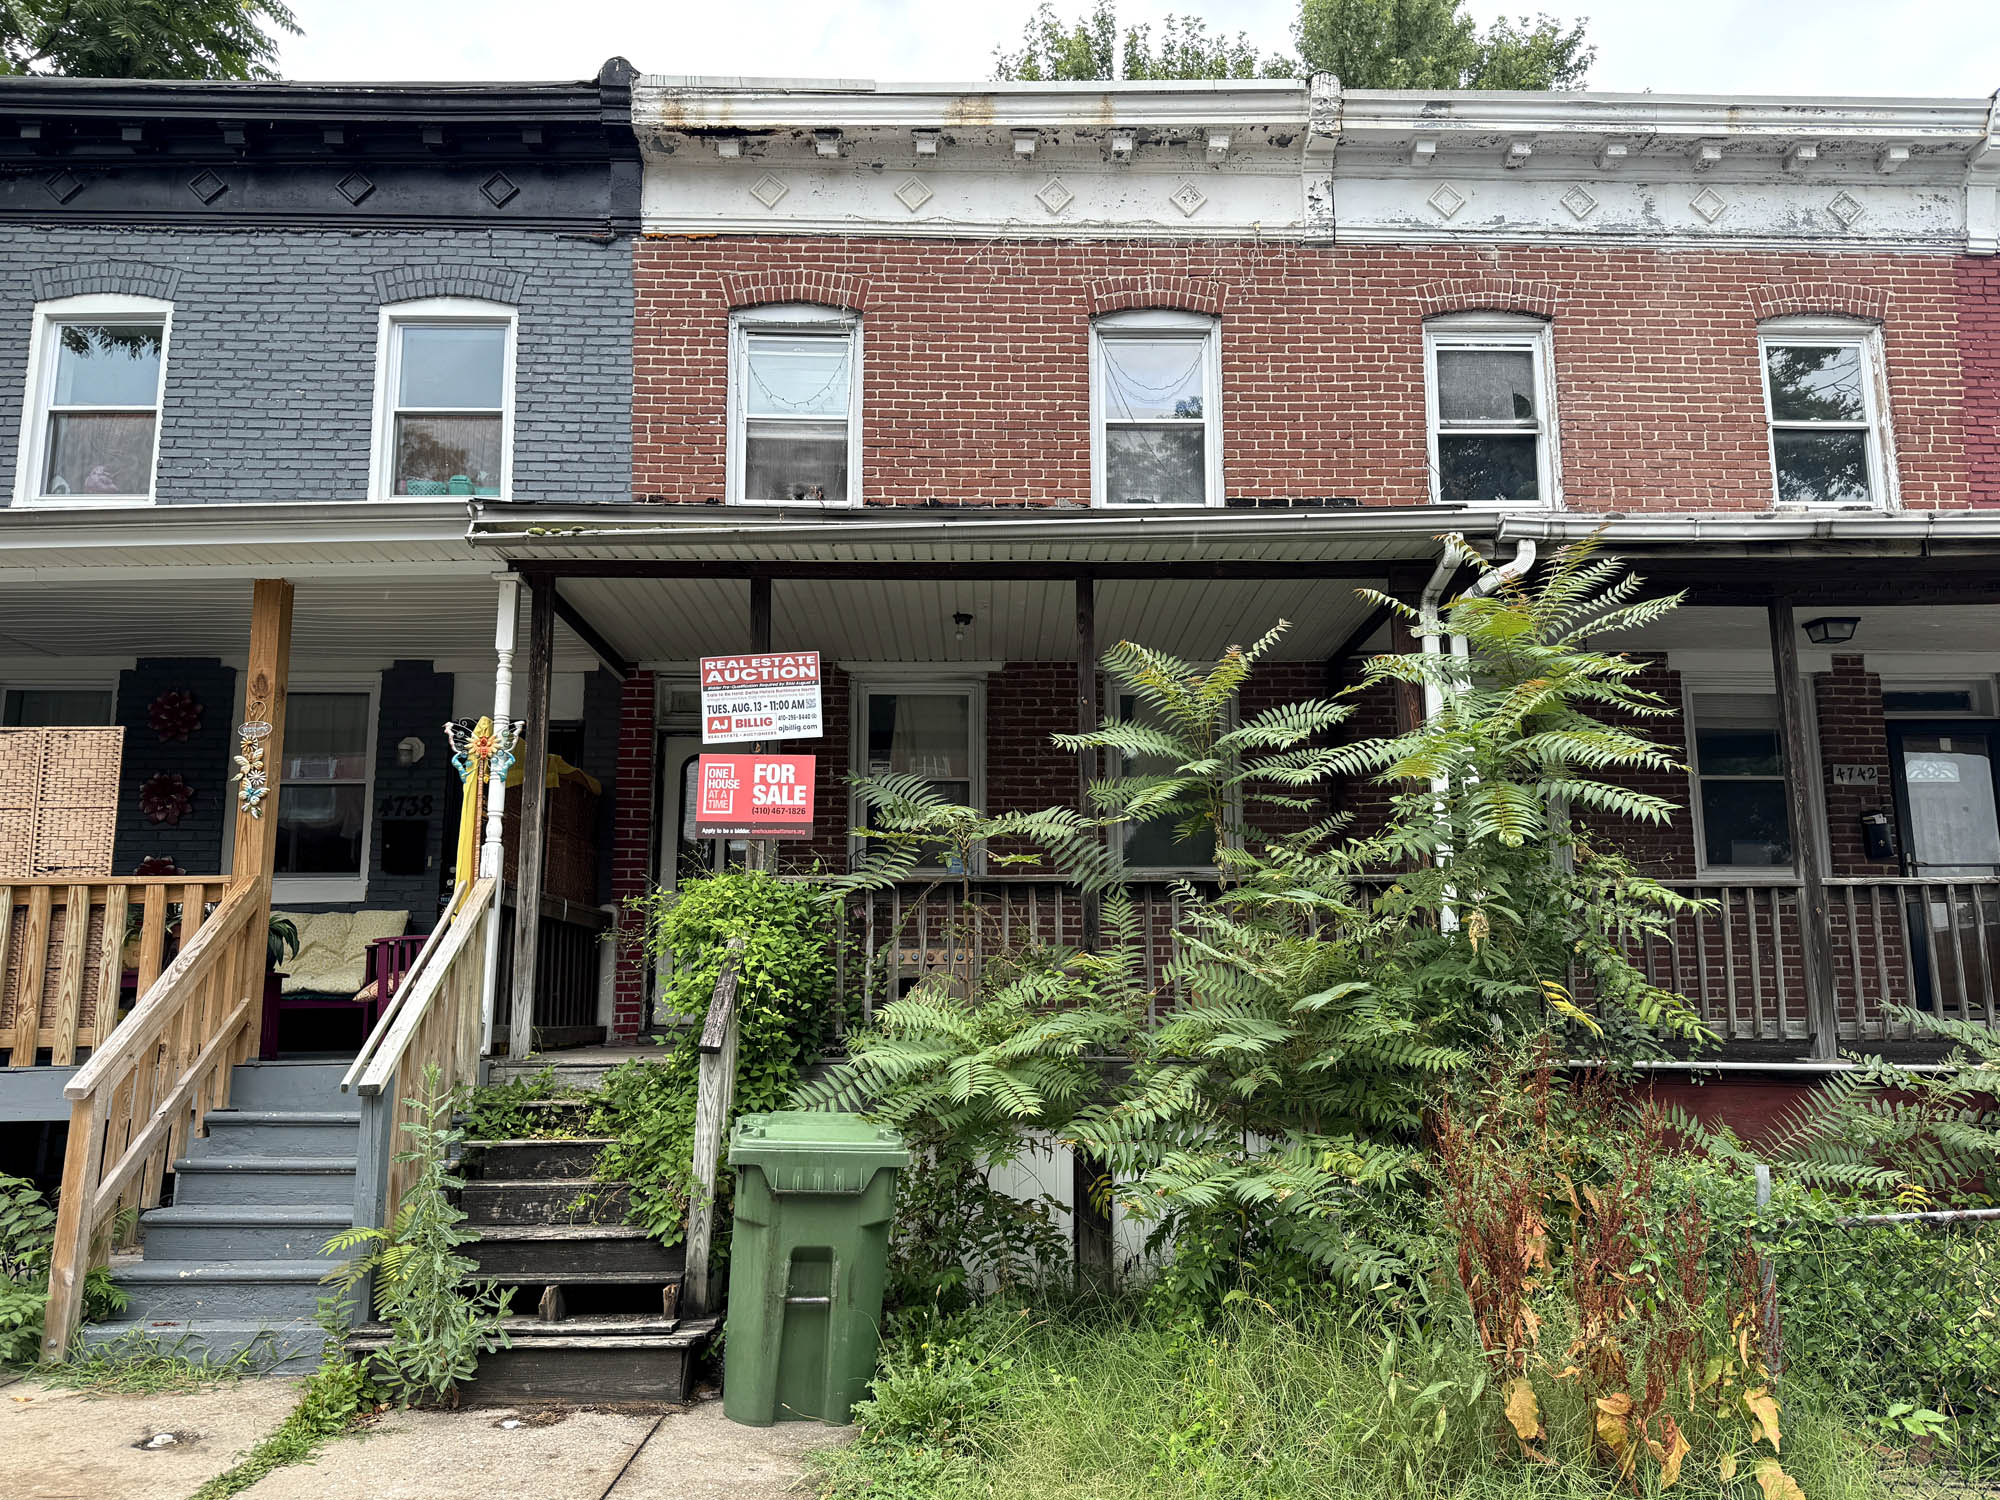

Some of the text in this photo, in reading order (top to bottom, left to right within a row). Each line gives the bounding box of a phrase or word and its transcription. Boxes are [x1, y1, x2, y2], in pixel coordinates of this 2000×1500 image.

[705, 656, 816, 670] REAL ESTATE
[706, 666, 816, 683] AUCTION
[707, 704, 730, 715] TUES.
[732, 702, 753, 713] AUG.
[754, 701, 762, 712] 13
[769, 700, 790, 711] 11:00
[791, 699, 805, 710] AM
[711, 717, 773, 731] AJ BILLIG
[778, 723, 818, 733] ajbillig.com
[709, 768, 729, 779] ONE
[754, 763, 796, 784] FOR
[1836, 767, 1877, 782] 4742
[708, 779, 740, 789] HOUSE
[708, 790, 727, 799] AT A
[752, 785, 807, 805] SALE
[378, 795, 433, 817] 4738
[708, 800, 728, 809] TIME
[752, 807, 806, 815] (410) 467-1826
